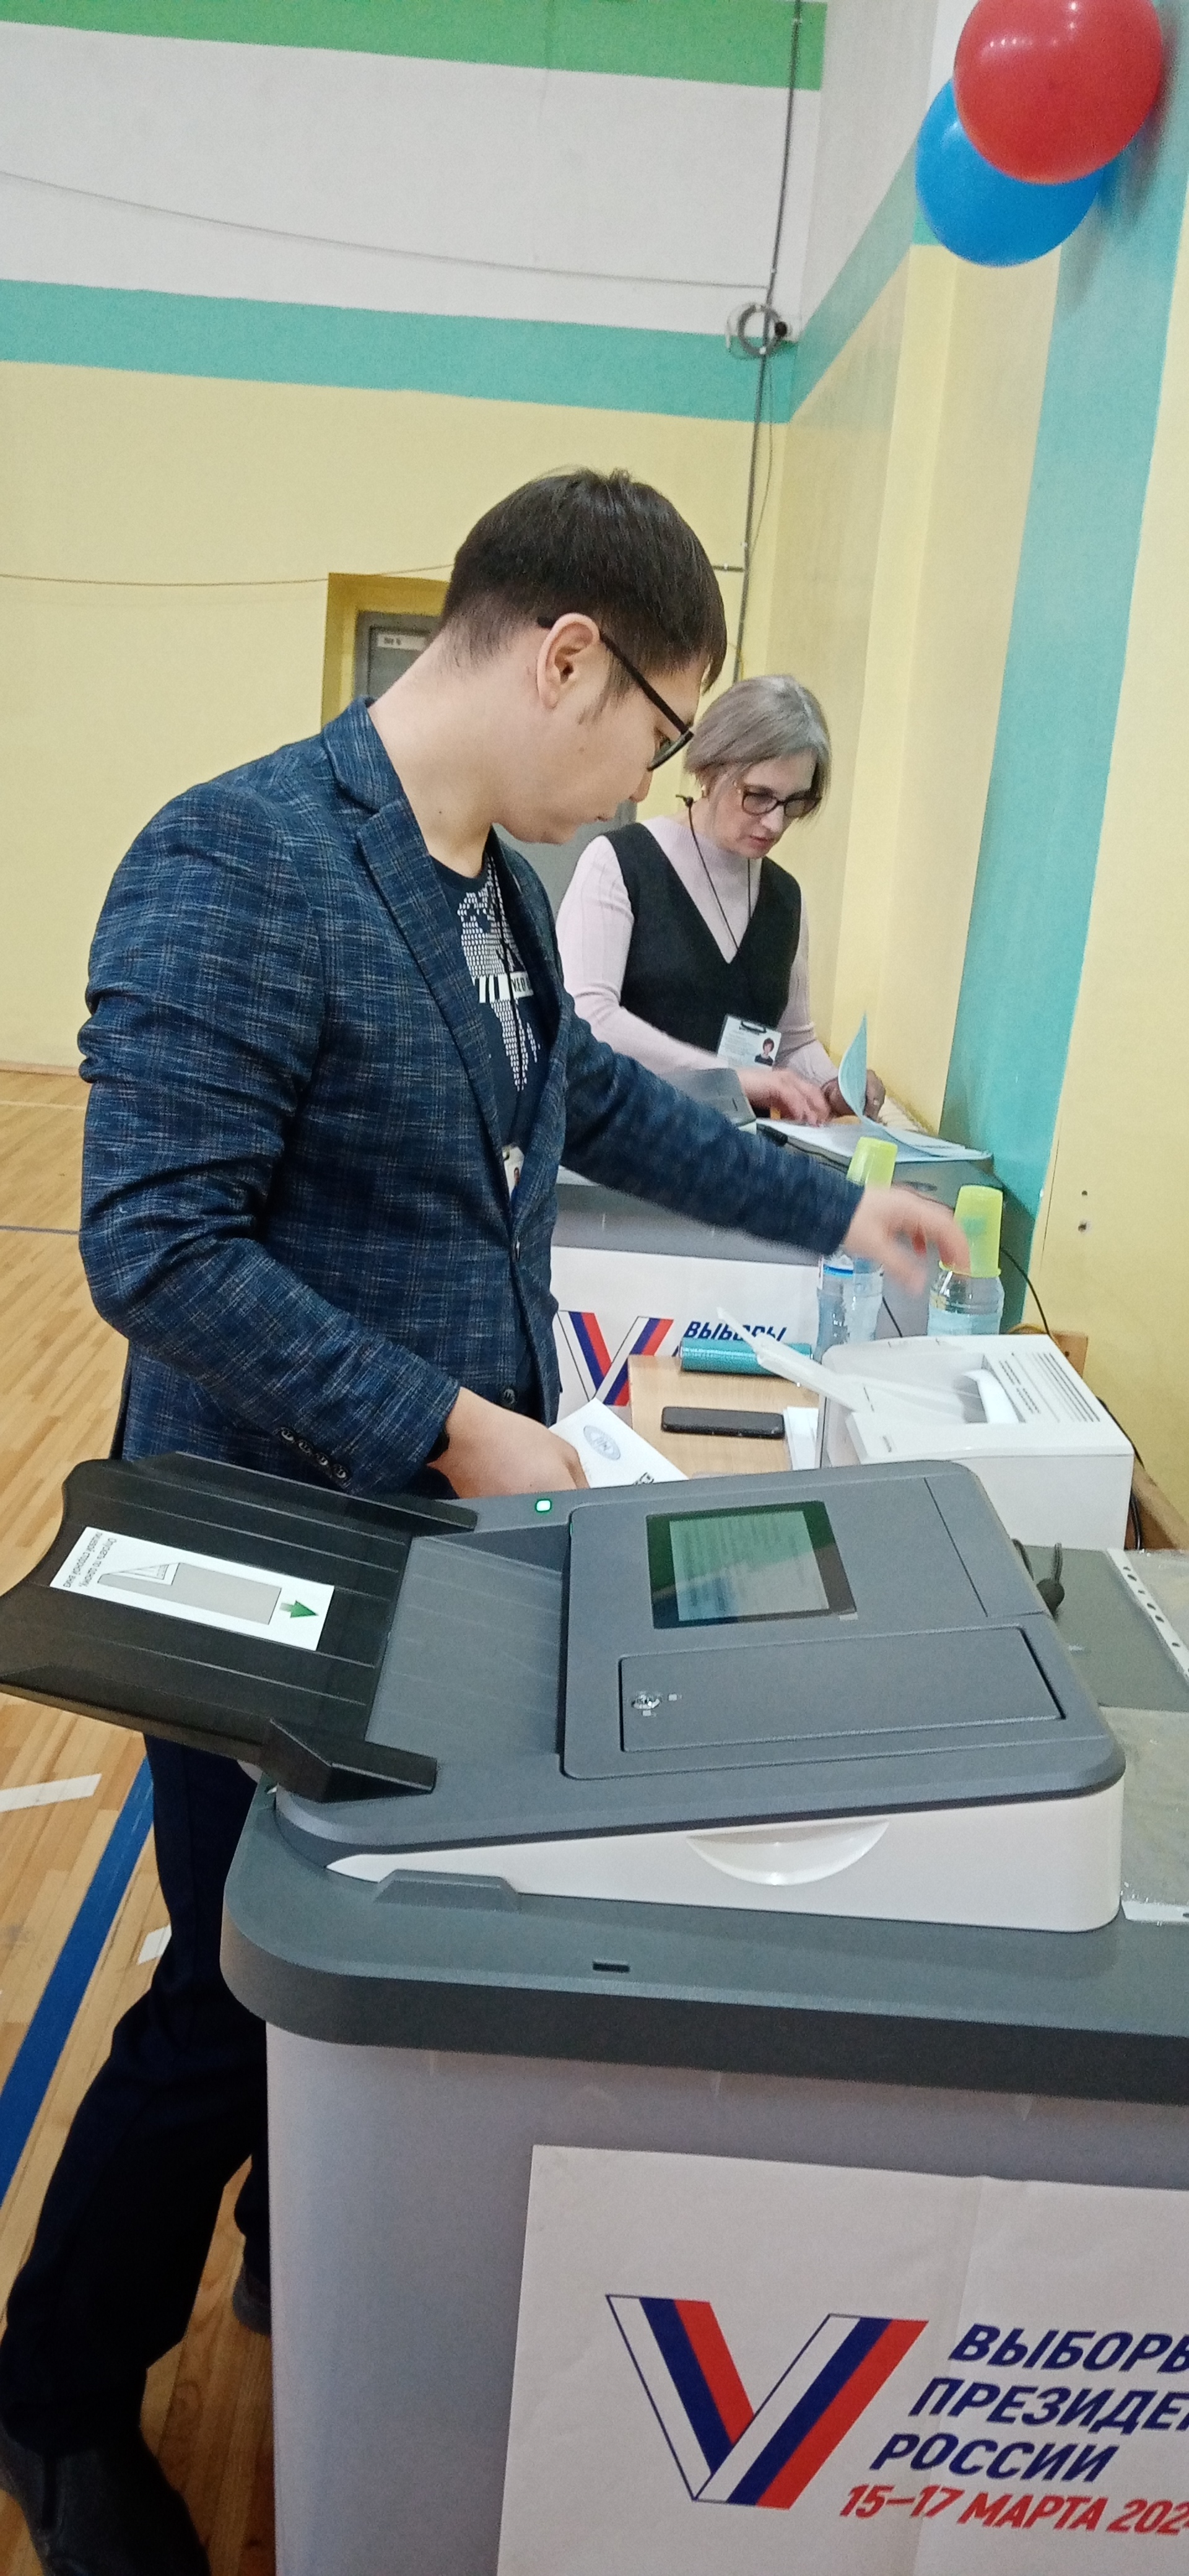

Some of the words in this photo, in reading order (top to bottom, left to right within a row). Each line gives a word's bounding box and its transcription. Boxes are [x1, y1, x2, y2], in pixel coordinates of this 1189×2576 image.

[869, 2432, 1120, 2483] РОССИИ
[956, 2491, 1108, 2531] МАРТА
[1105, 2497, 1189, 2535] 202
